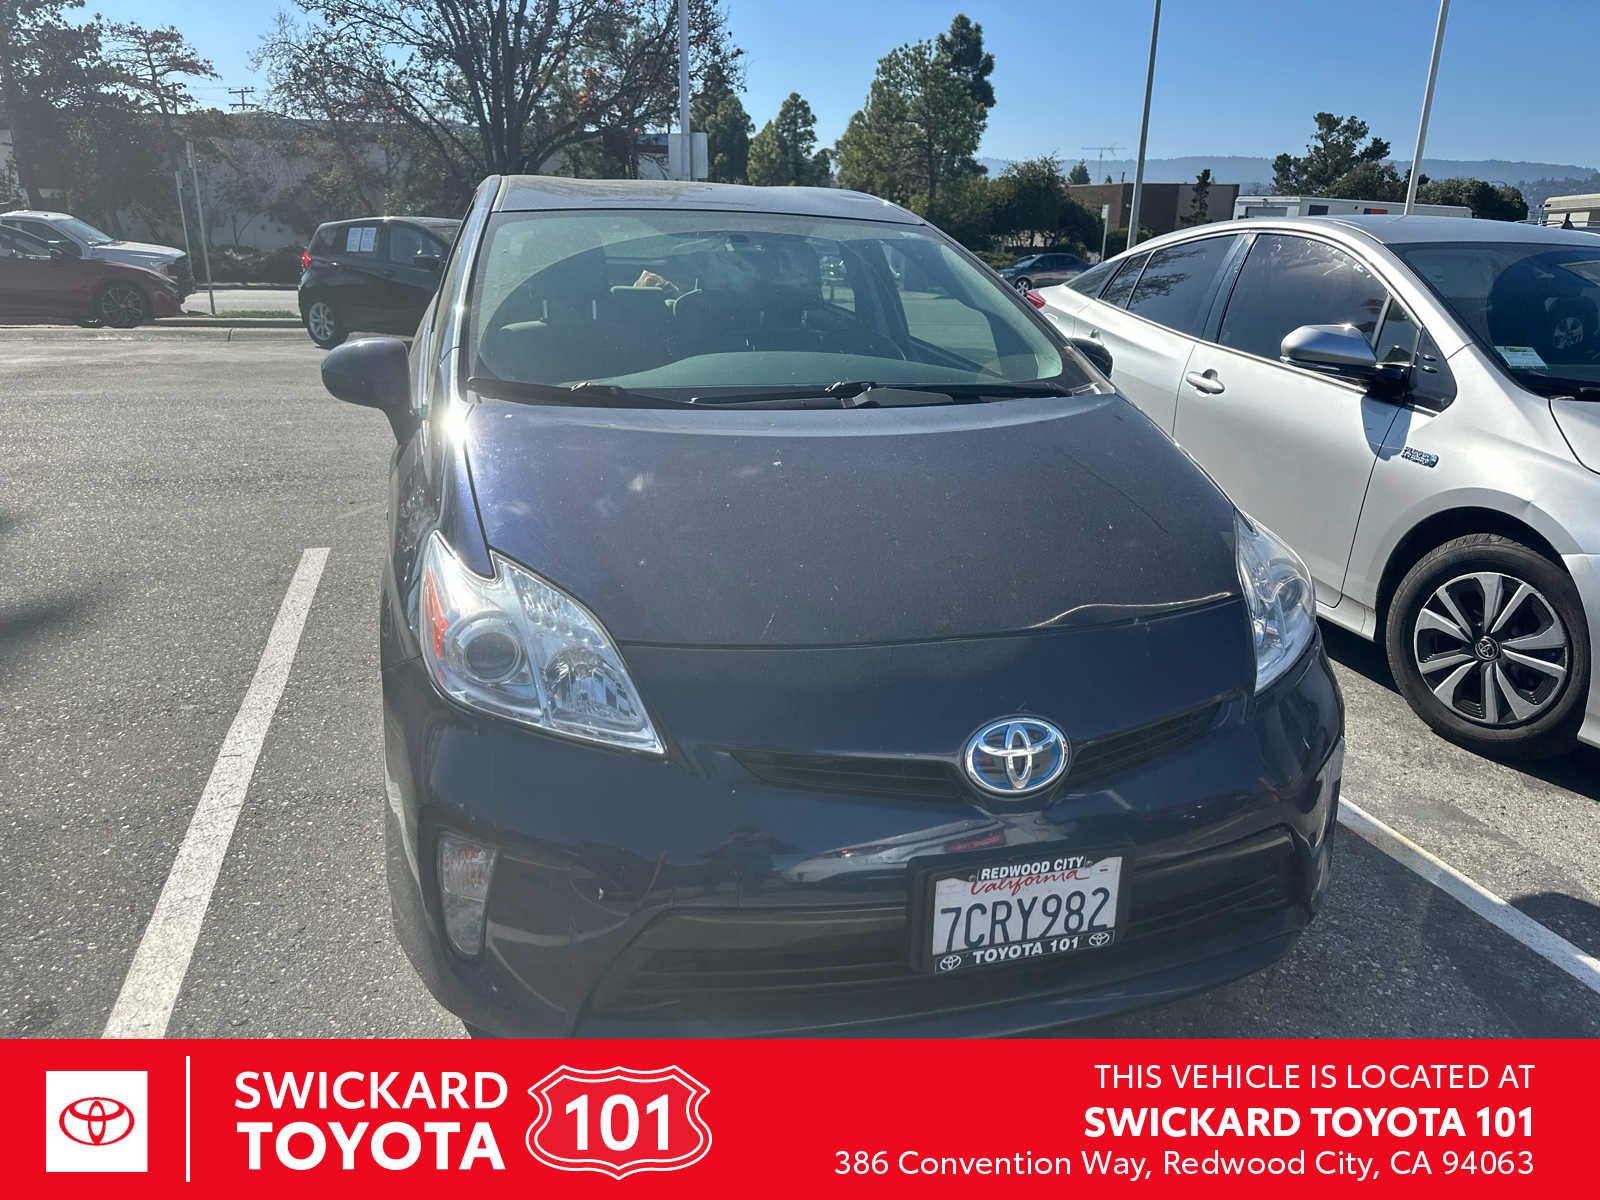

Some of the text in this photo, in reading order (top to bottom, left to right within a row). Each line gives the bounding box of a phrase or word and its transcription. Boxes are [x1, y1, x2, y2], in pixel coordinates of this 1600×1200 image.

[981, 856, 1084, 880] REDWOOD CITY
[970, 869, 1089, 896] California
[940, 887, 1110, 952] 7CRY982
[973, 936, 1079, 964] TOYOTA 101
